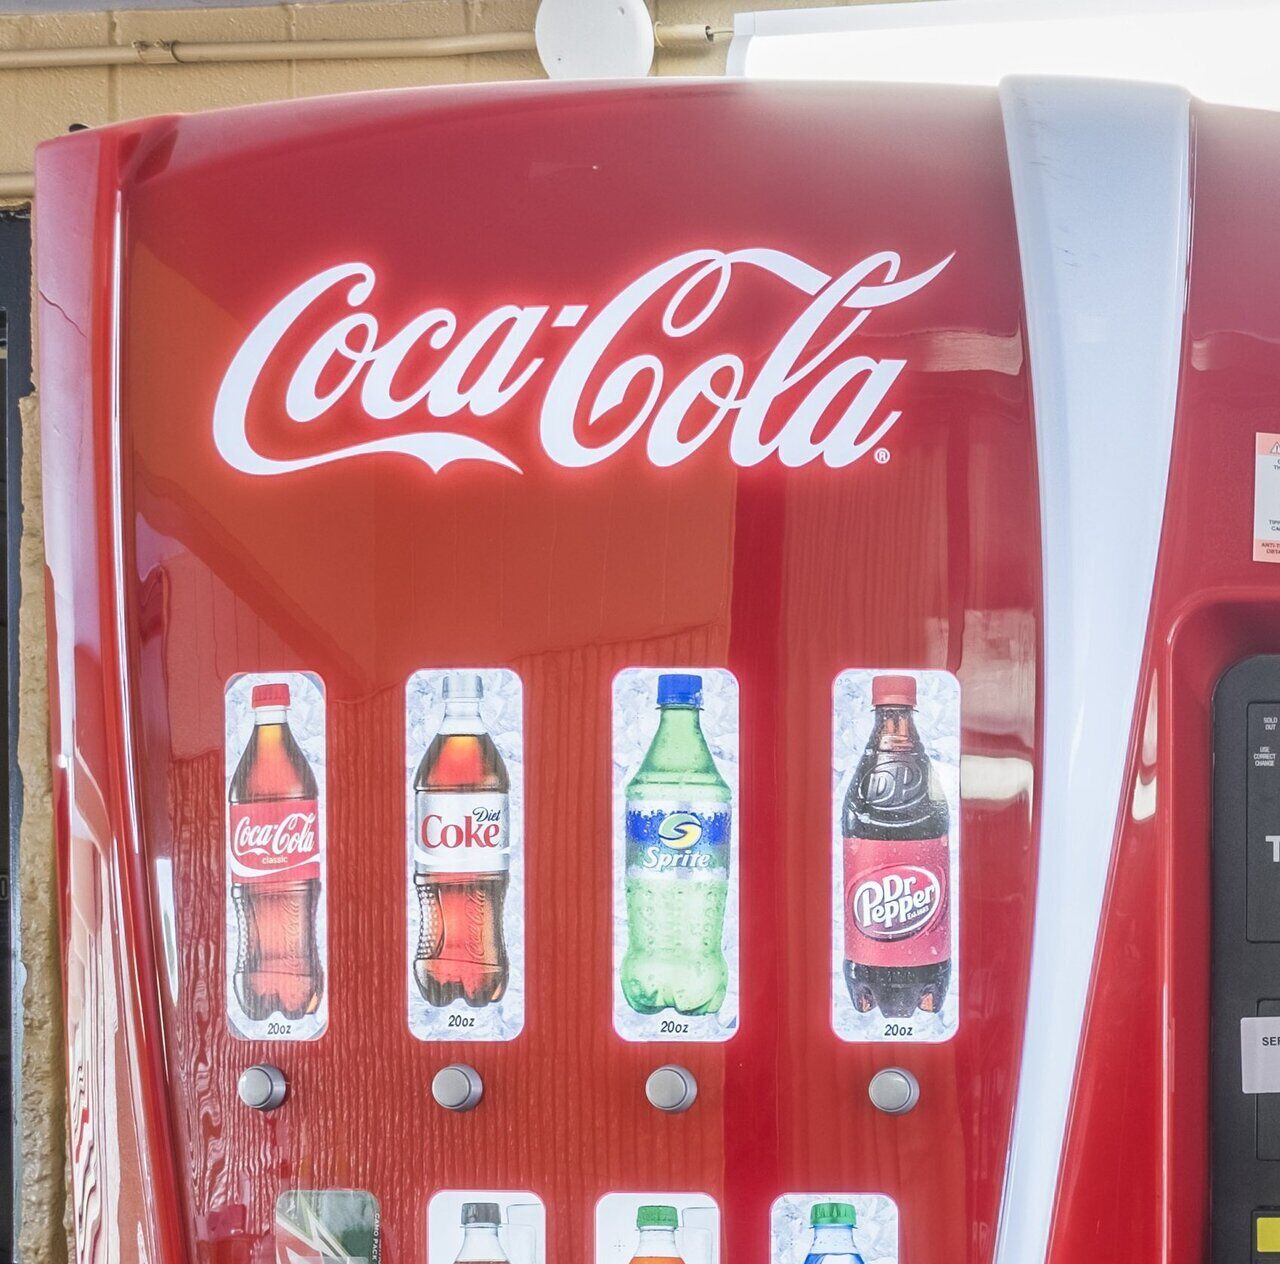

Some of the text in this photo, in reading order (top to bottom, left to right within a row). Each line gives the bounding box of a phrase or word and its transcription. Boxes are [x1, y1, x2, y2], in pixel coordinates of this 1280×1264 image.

[212, 247, 956, 474] Coca-Cola
[472, 806, 501, 823] Diet
[234, 813, 316, 857] Coca-Cola
[421, 814, 501, 849] Coke
[262, 855, 288, 864] classic
[643, 846, 711, 872] Sprite
[882, 874, 917, 898] Dr
[863, 879, 936, 929] Pepper
